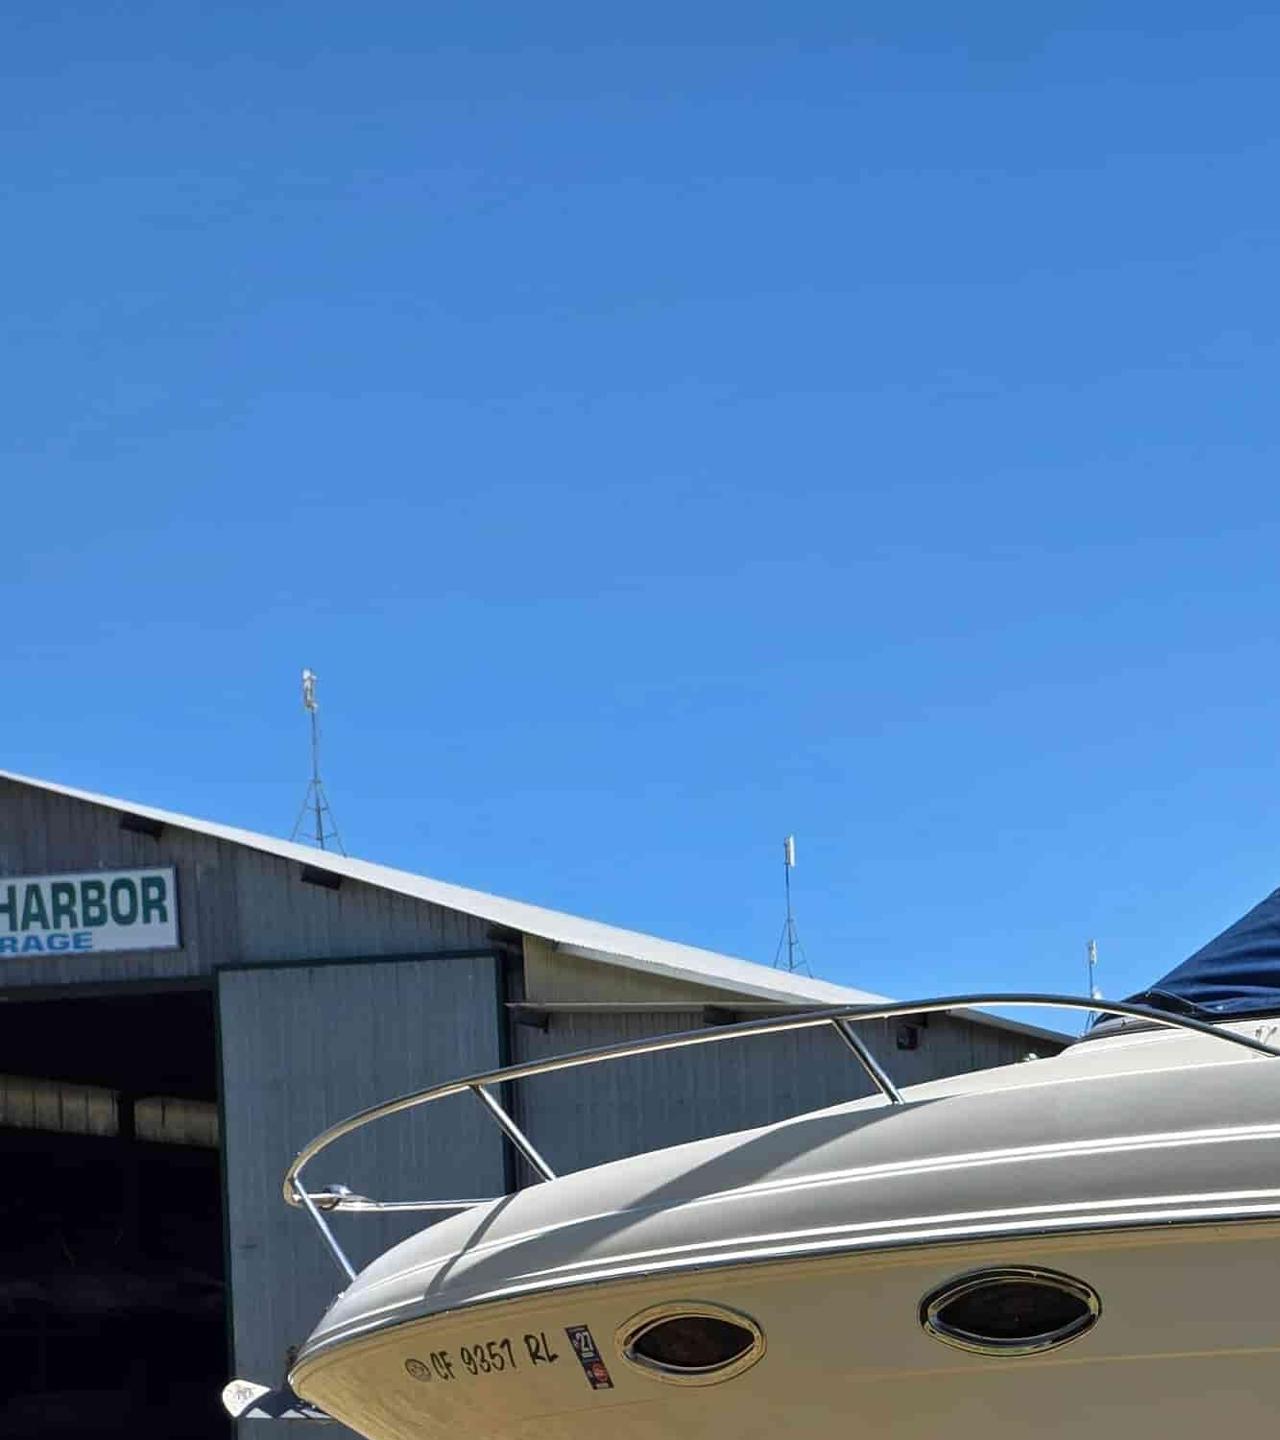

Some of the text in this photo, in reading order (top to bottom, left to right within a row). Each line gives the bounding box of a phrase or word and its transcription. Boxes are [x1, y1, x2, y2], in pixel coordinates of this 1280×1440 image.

[430, 1351, 456, 1380] CF
[524, 1332, 559, 1366] RL
[576, 1331, 593, 1352] 27
